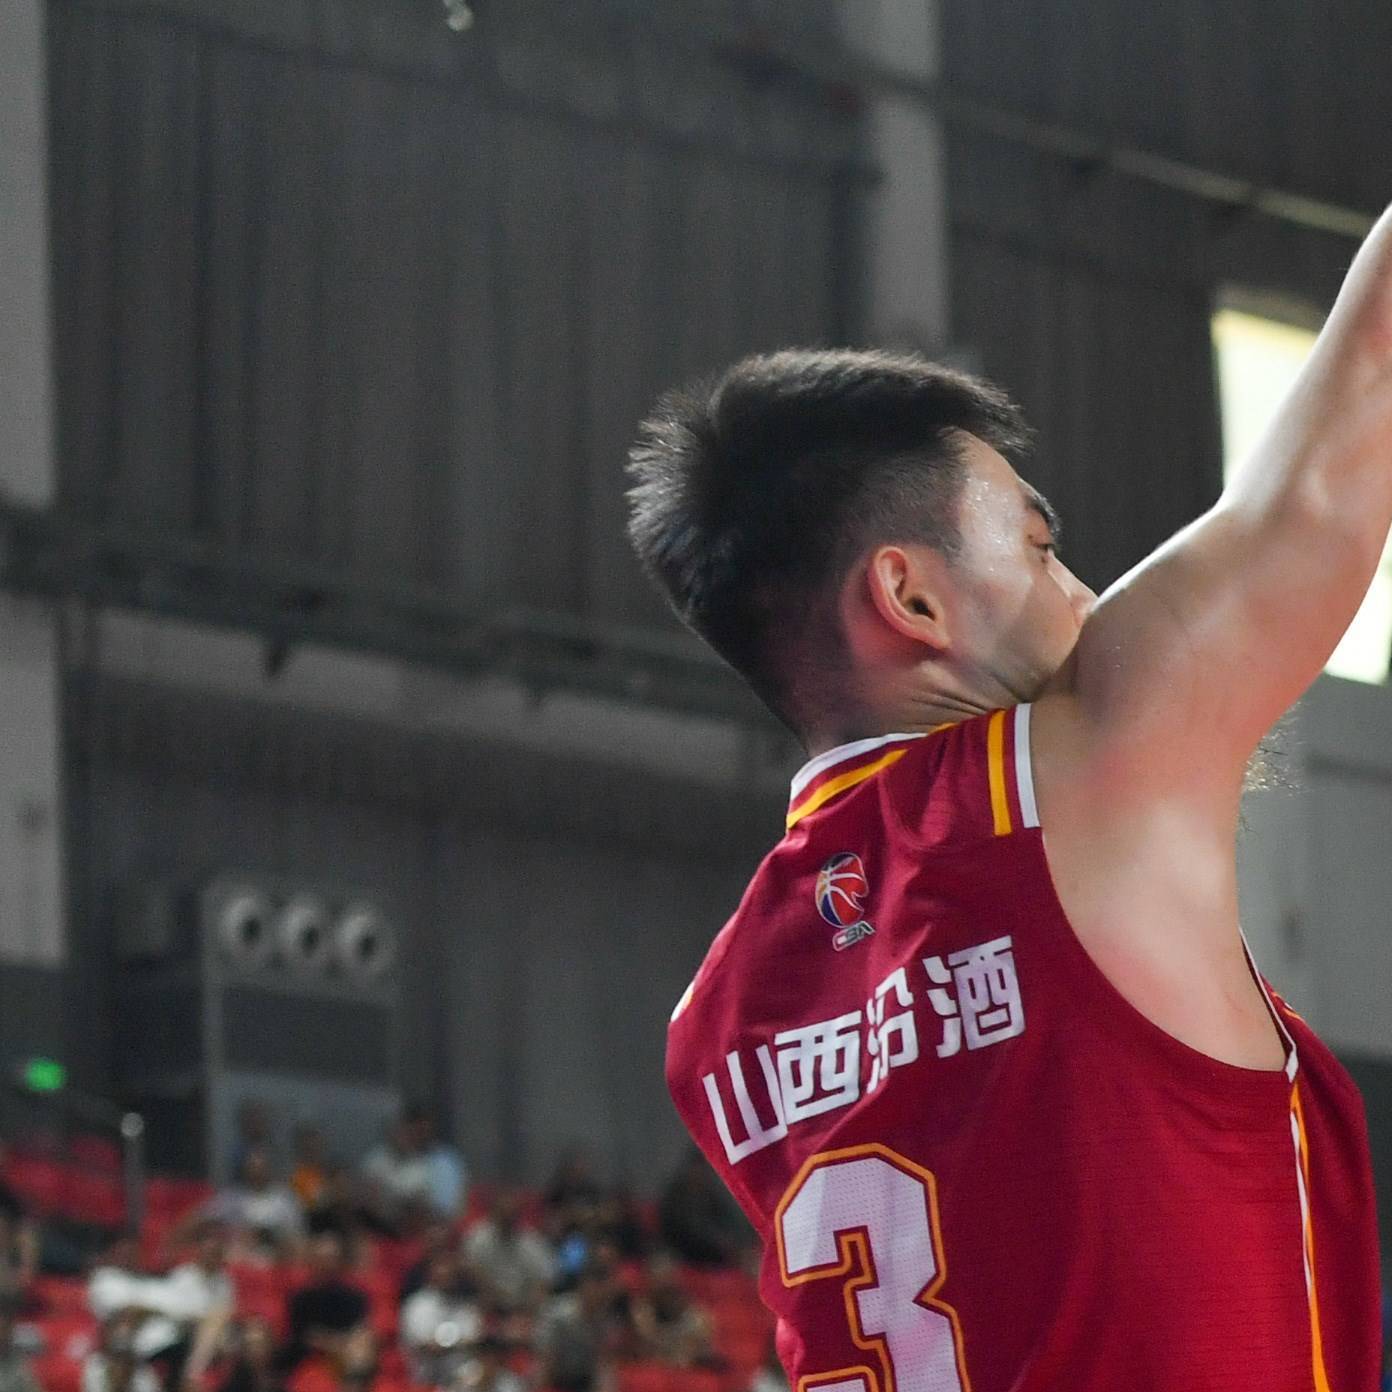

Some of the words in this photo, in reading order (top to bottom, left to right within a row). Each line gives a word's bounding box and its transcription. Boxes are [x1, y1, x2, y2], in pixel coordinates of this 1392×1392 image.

[832, 920, 875, 952] CBA
[702, 935, 1026, 1166] 山西汾酒
